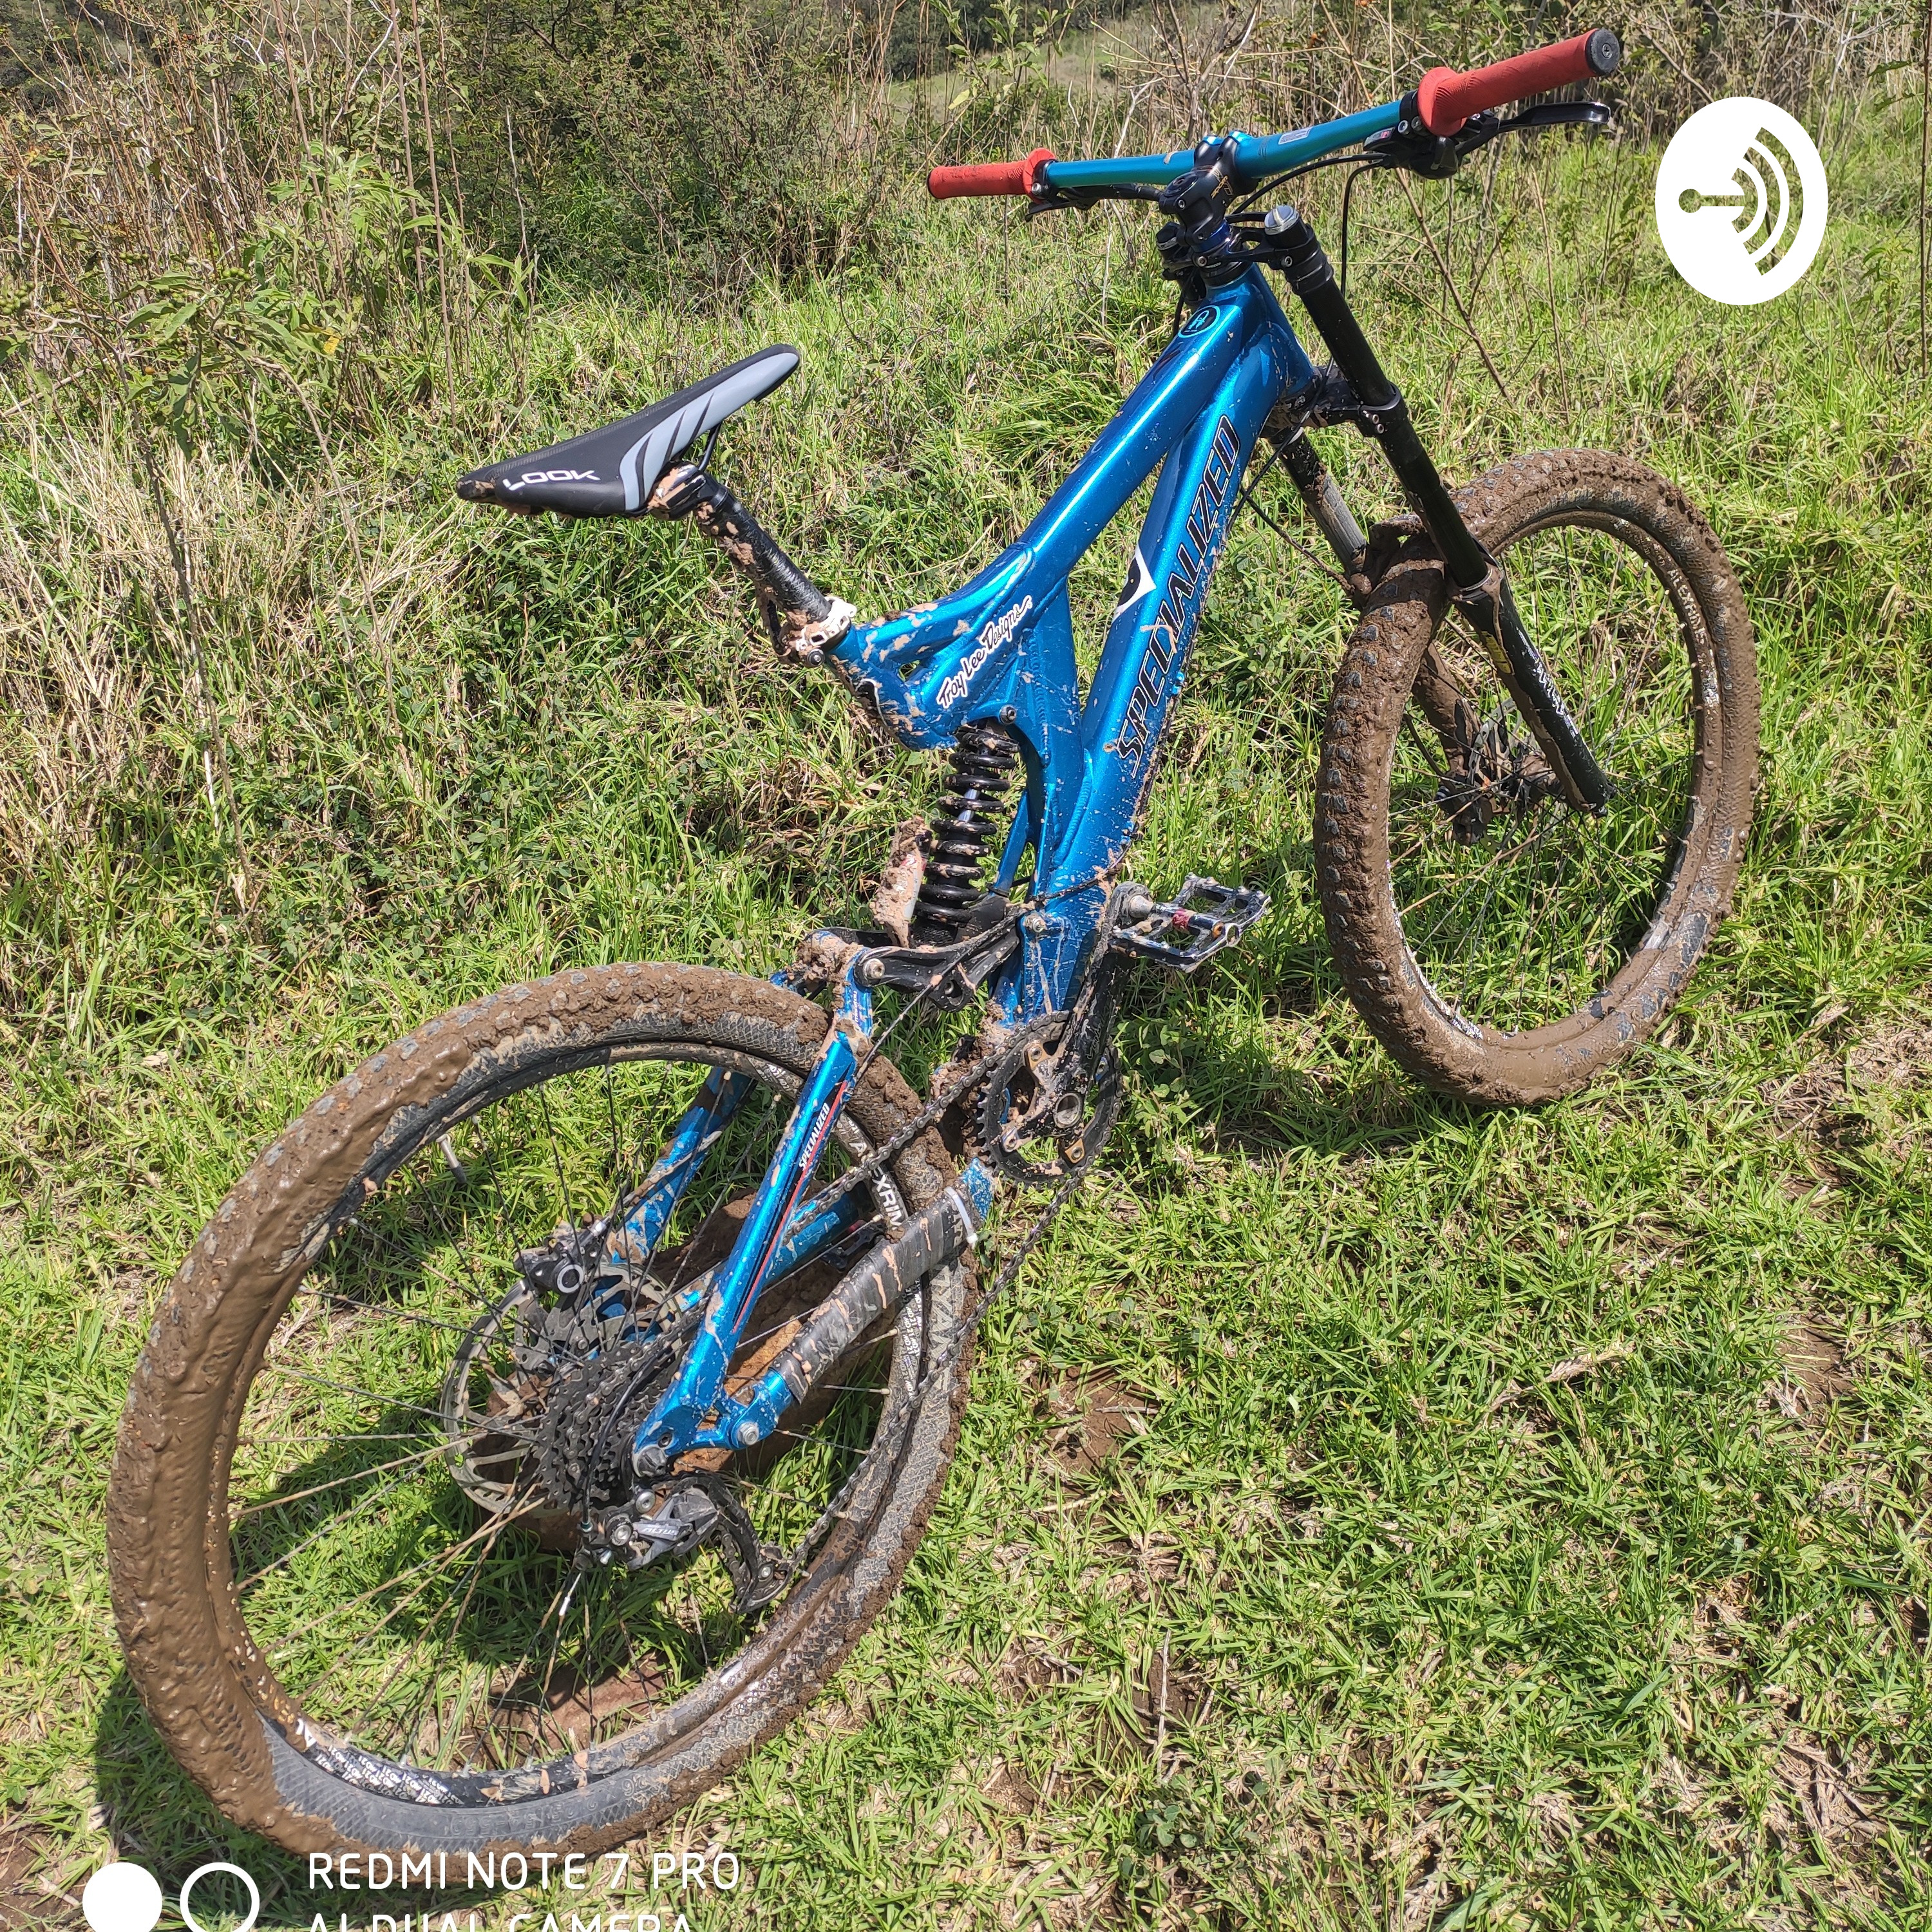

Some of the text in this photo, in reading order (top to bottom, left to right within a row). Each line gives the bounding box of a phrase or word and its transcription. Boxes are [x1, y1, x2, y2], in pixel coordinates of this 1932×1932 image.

[502, 469, 601, 491] LOOK
[1117, 415, 1240, 779] SPECIALIZED
[938, 596, 1031, 707] Troy Lee Designs
[798, 1102, 830, 1172] SPECIALIZED
[641, 1527, 679, 1535] ALTUS
